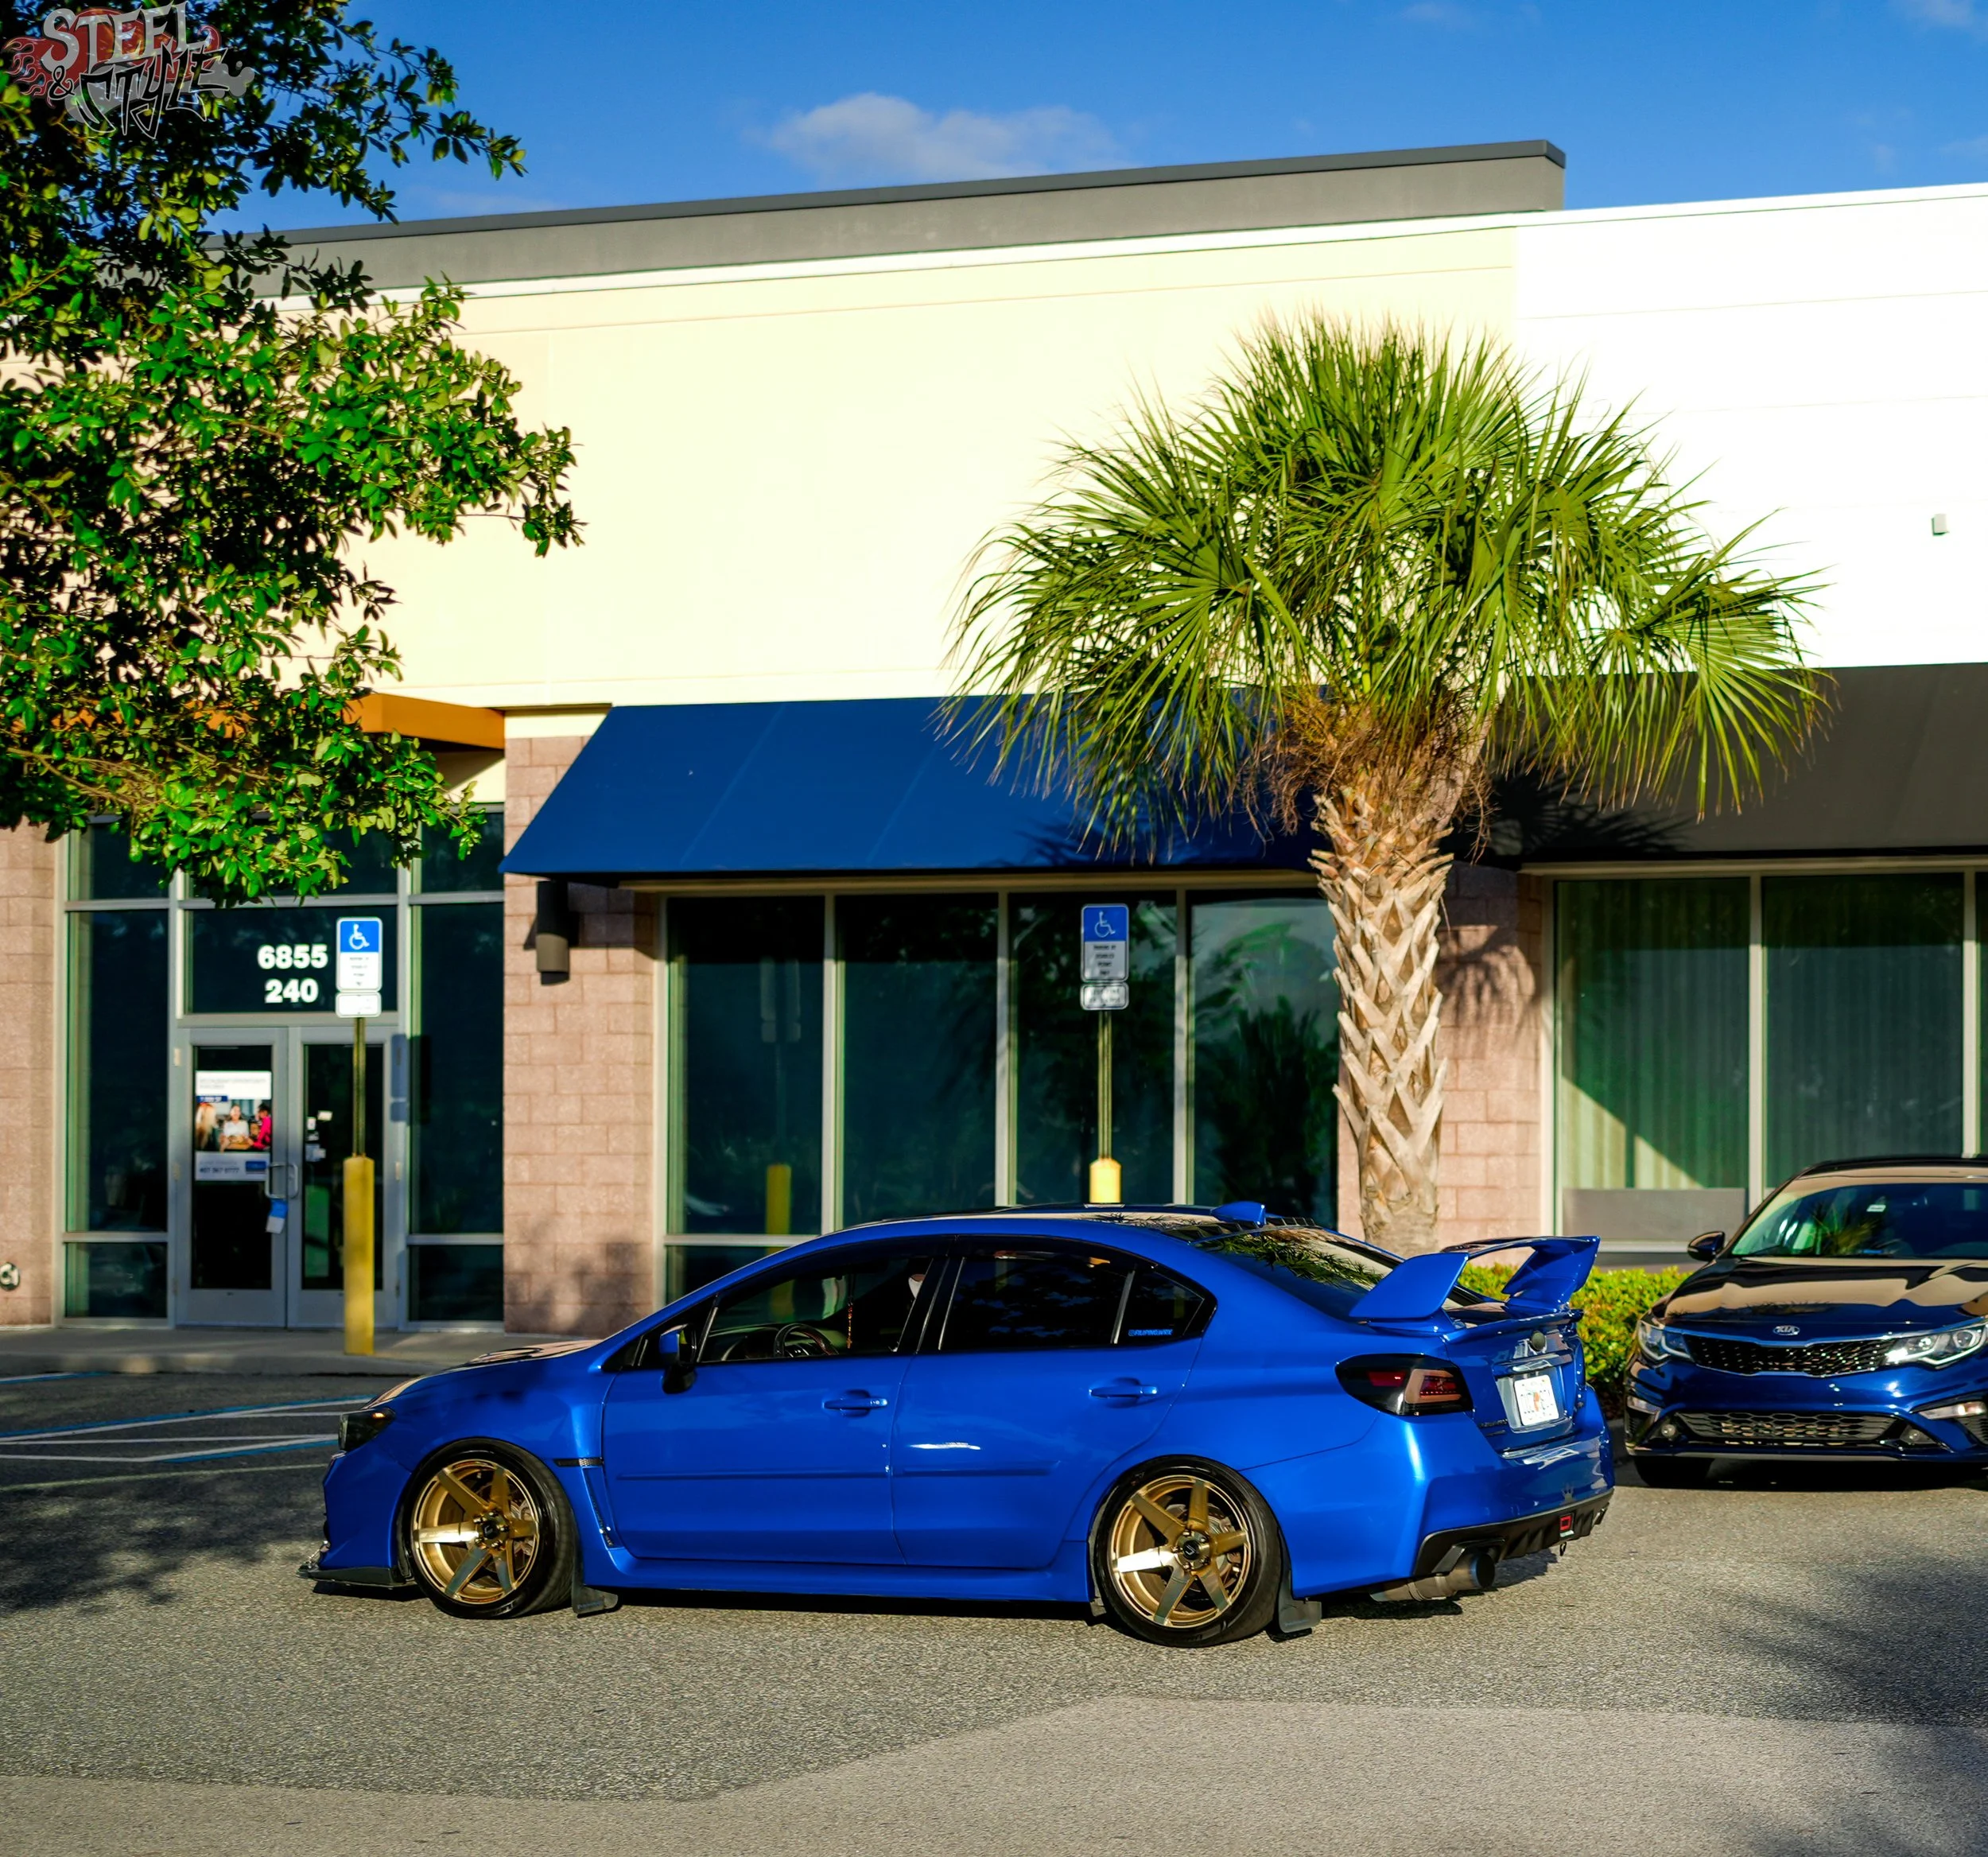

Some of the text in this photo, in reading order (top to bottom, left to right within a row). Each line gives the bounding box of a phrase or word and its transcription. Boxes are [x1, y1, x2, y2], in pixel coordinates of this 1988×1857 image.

[258, 944, 328, 969] 6855
[265, 977, 319, 1004] 240
[1775, 1325, 1799, 1335] KIA
